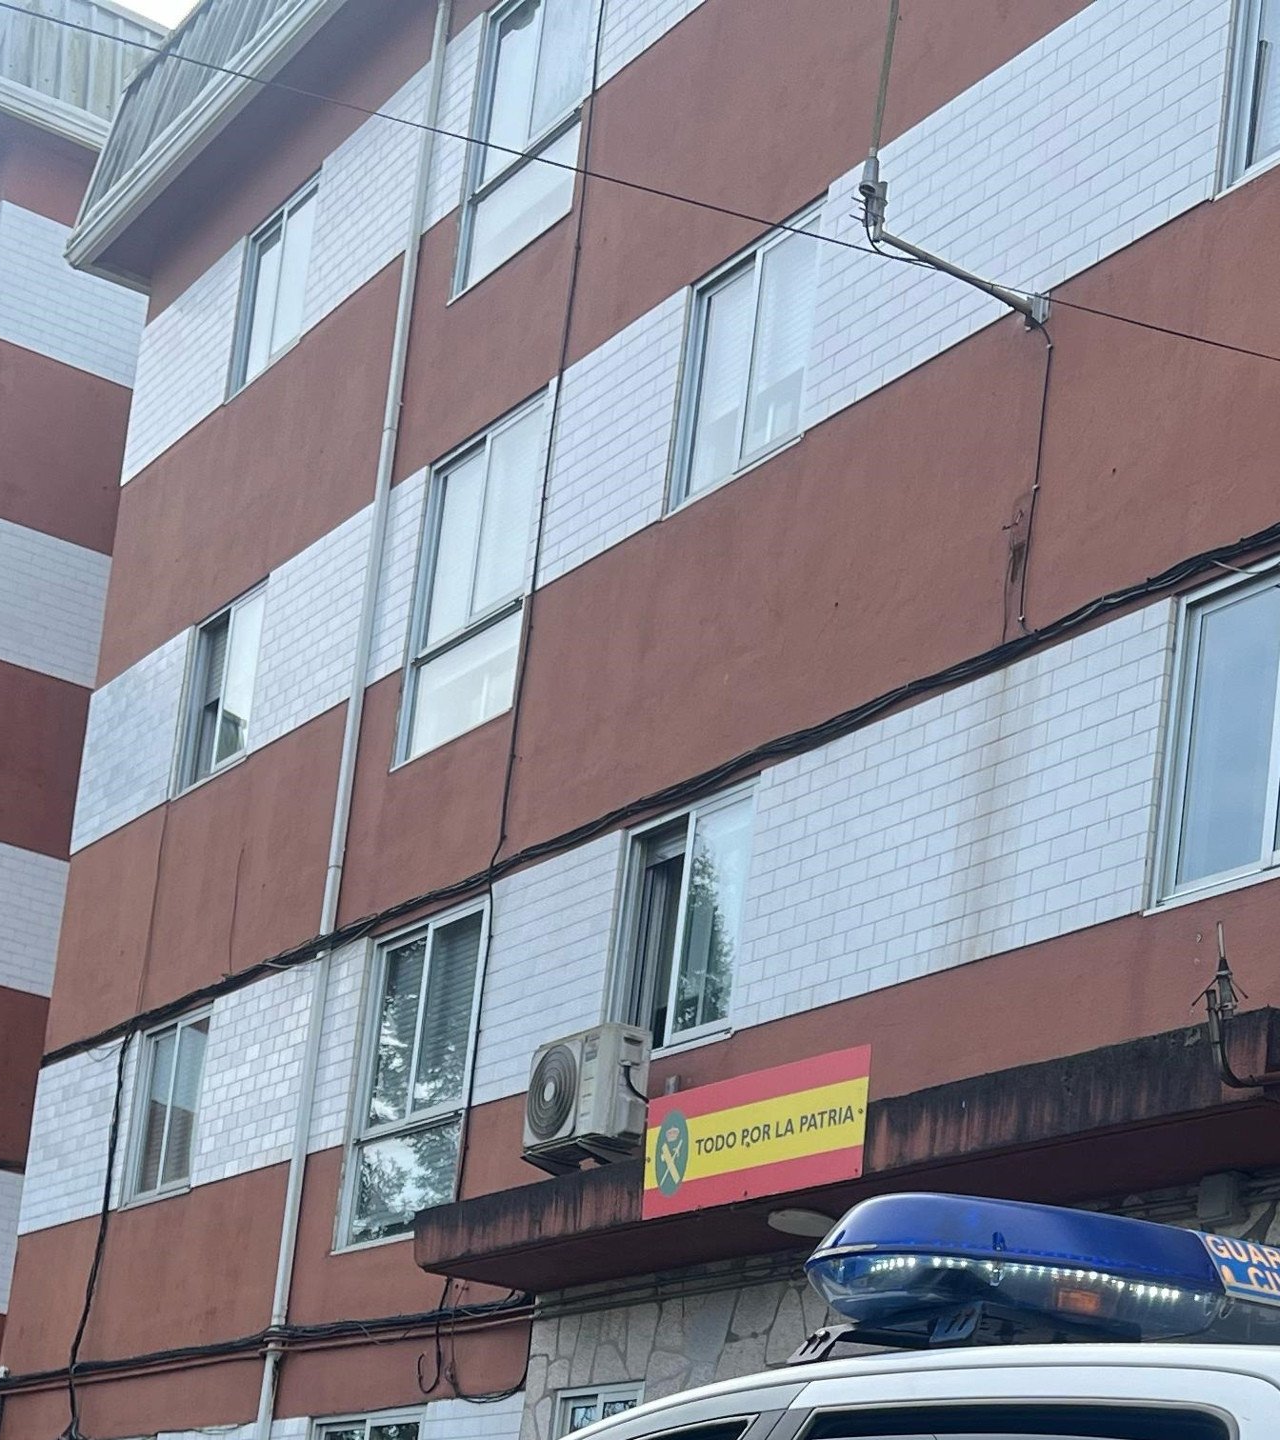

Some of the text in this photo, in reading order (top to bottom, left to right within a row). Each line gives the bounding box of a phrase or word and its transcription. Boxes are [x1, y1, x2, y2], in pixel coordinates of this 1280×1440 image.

[696, 1105, 854, 1155] TODO POR LA PATRIA
